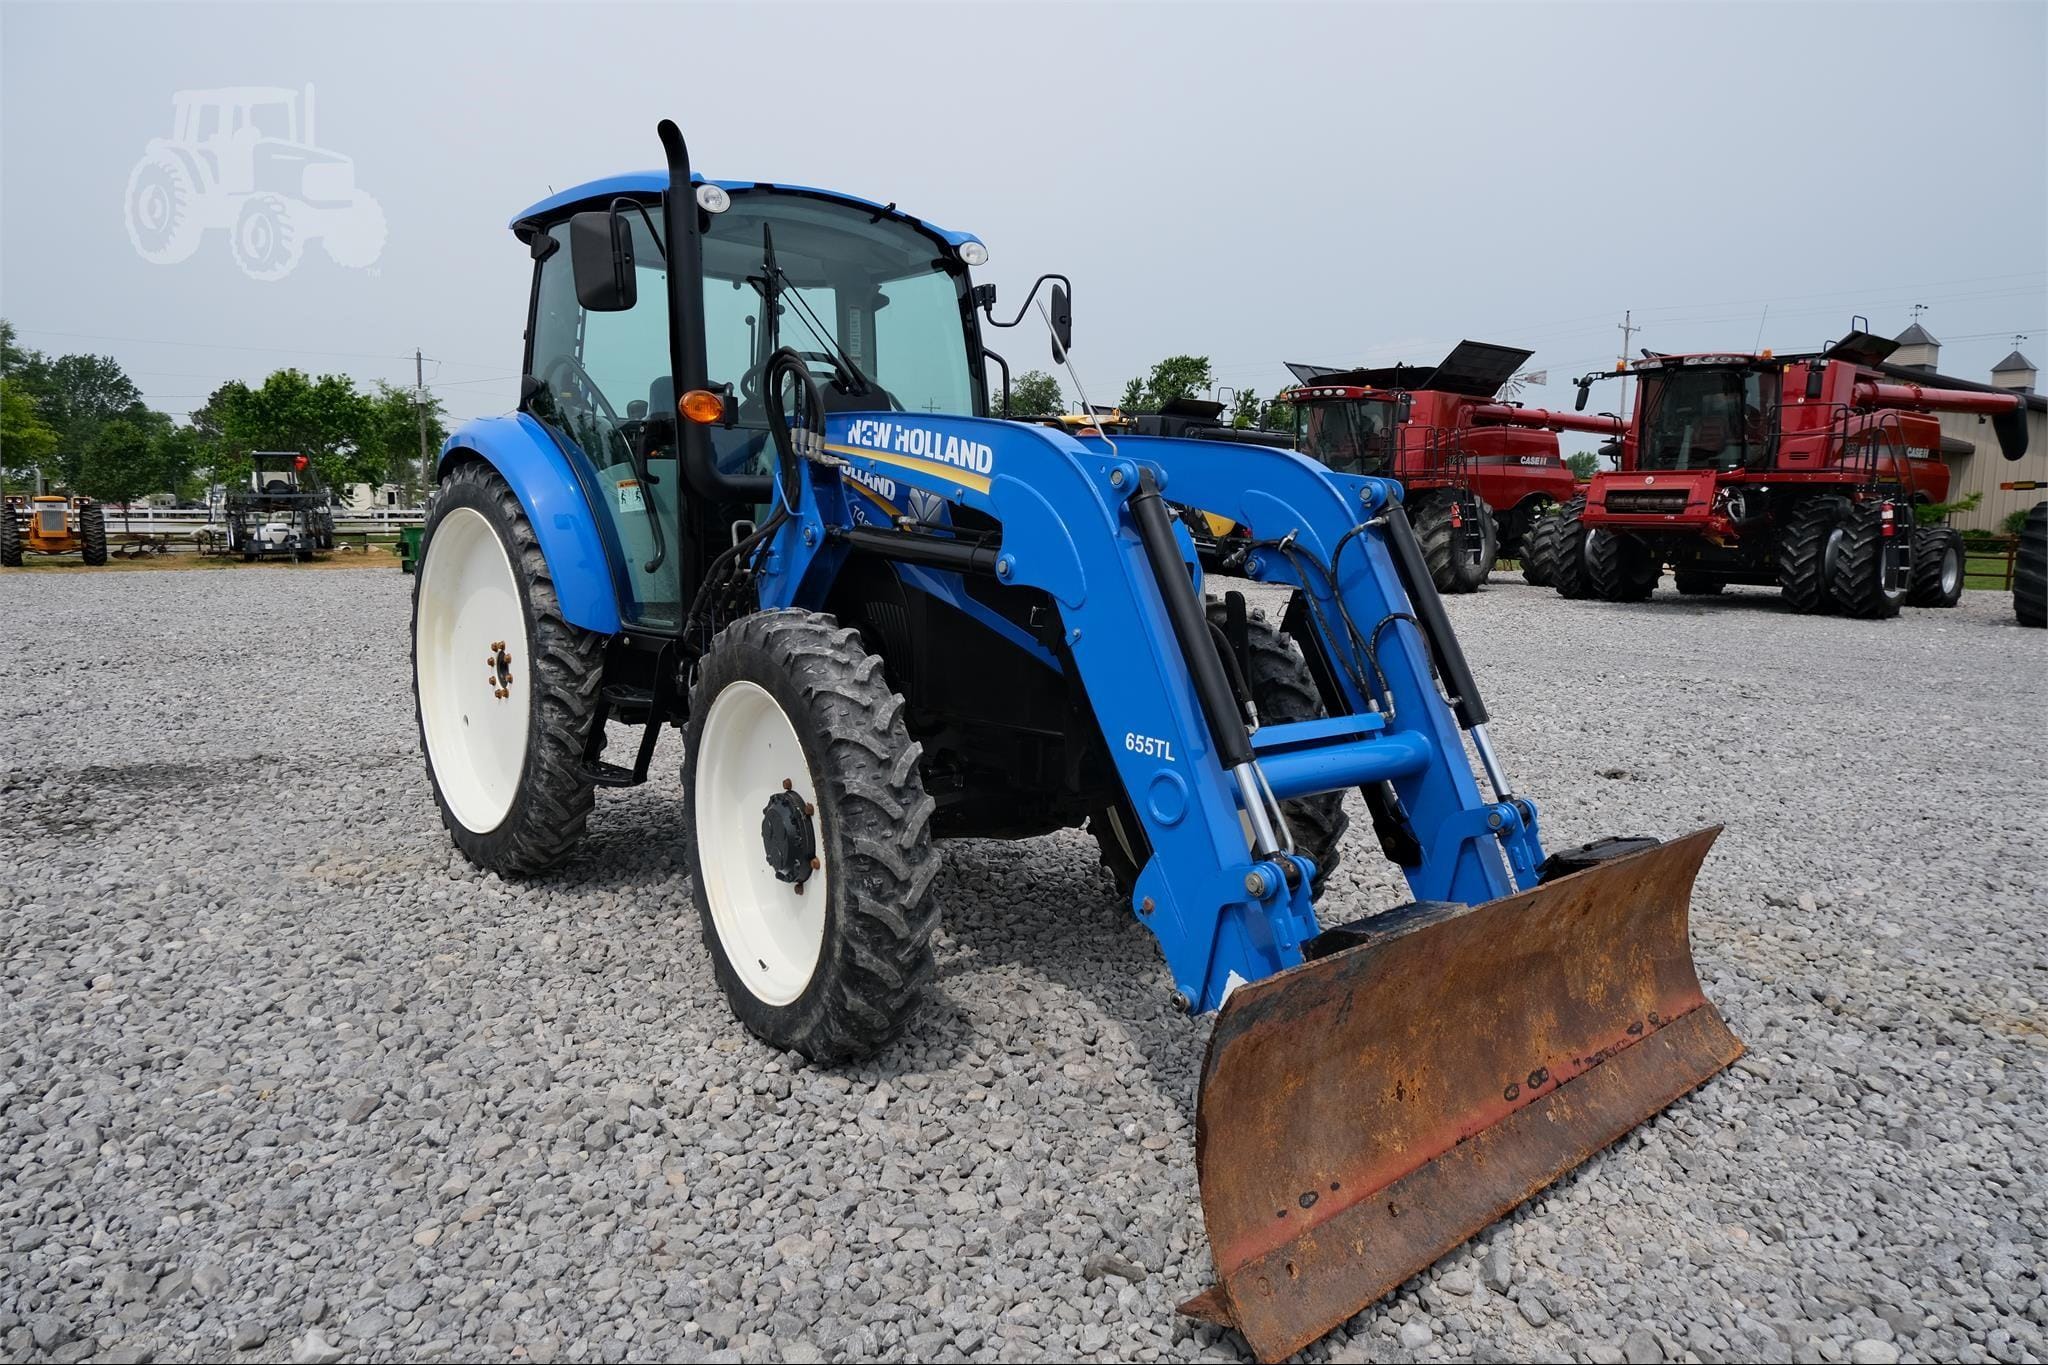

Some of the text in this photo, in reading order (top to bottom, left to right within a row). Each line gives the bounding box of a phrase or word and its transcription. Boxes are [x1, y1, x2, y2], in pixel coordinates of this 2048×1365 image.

[848, 420, 993, 474] NEW HOLLAND
[1907, 447, 1923, 458] CASE
[1520, 455, 1540, 465] CASE
[1125, 732, 1176, 762] 655TL
